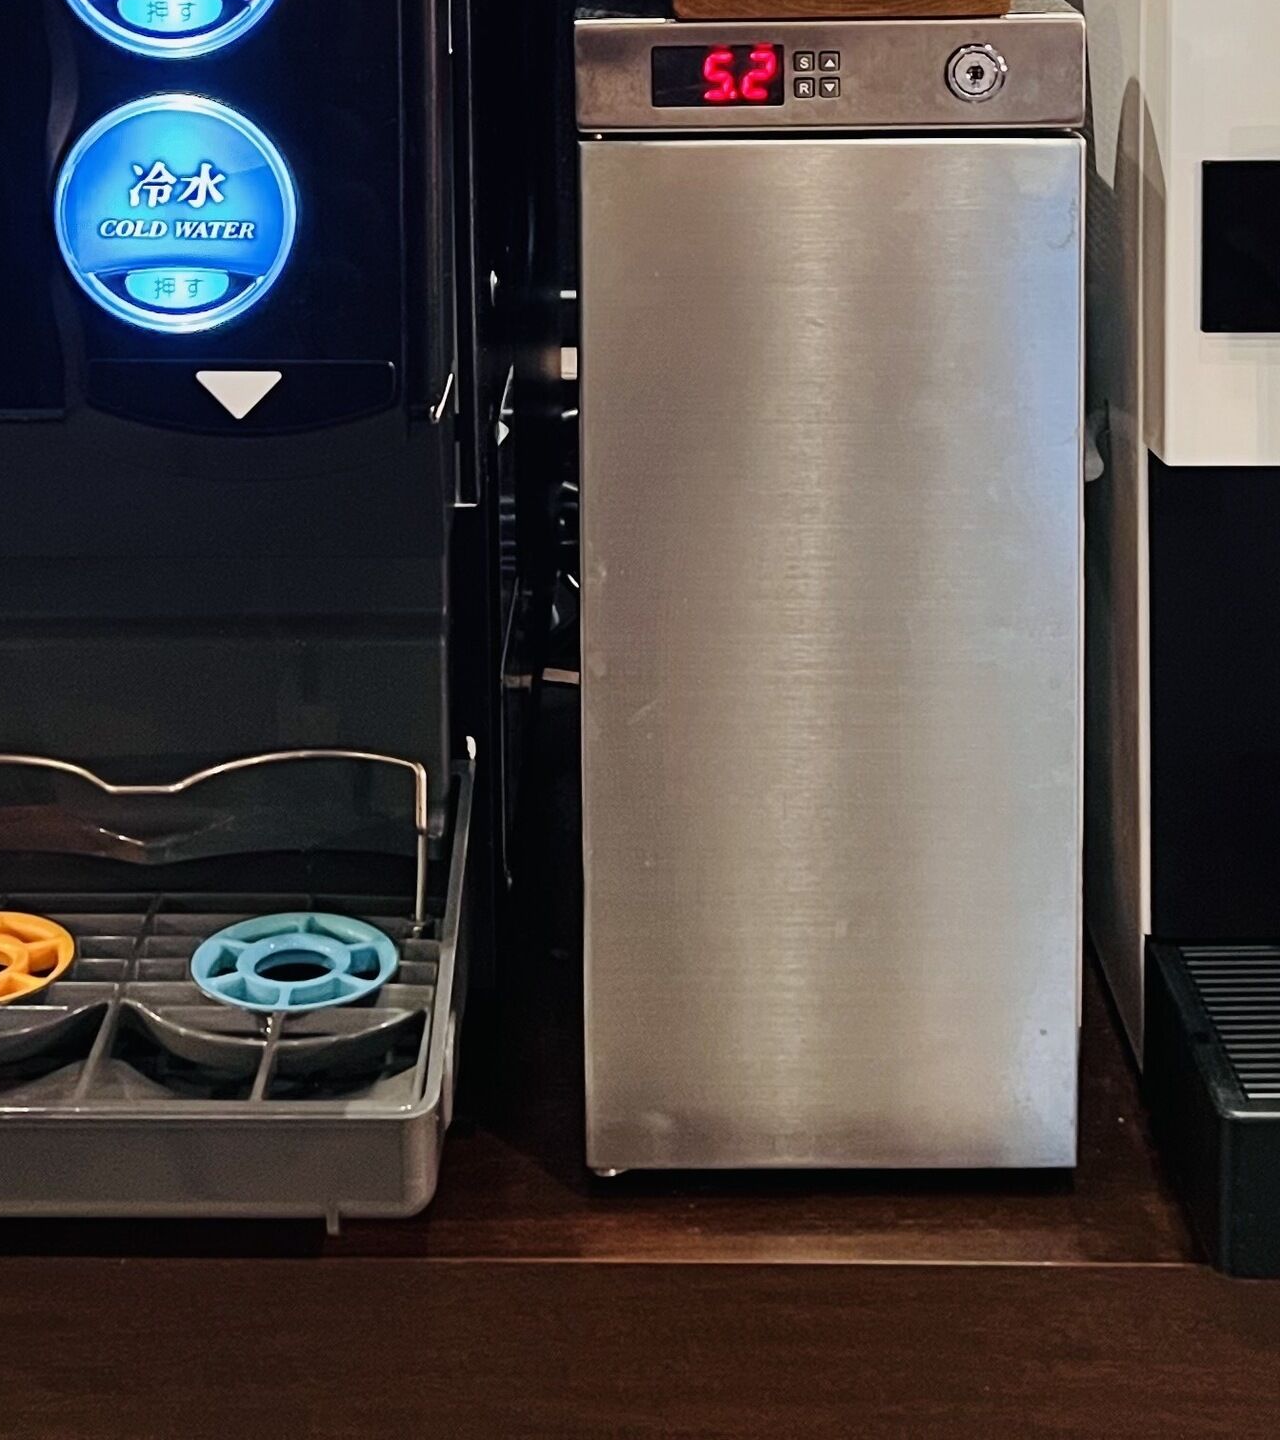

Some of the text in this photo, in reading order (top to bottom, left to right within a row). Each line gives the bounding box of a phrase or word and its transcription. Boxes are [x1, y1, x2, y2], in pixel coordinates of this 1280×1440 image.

[799, 56, 810, 69] S
[799, 82, 810, 95] R
[129, 160, 226, 209] 冷水
[100, 219, 256, 240] COLD WATER
[154, 277, 204, 299] 押す
